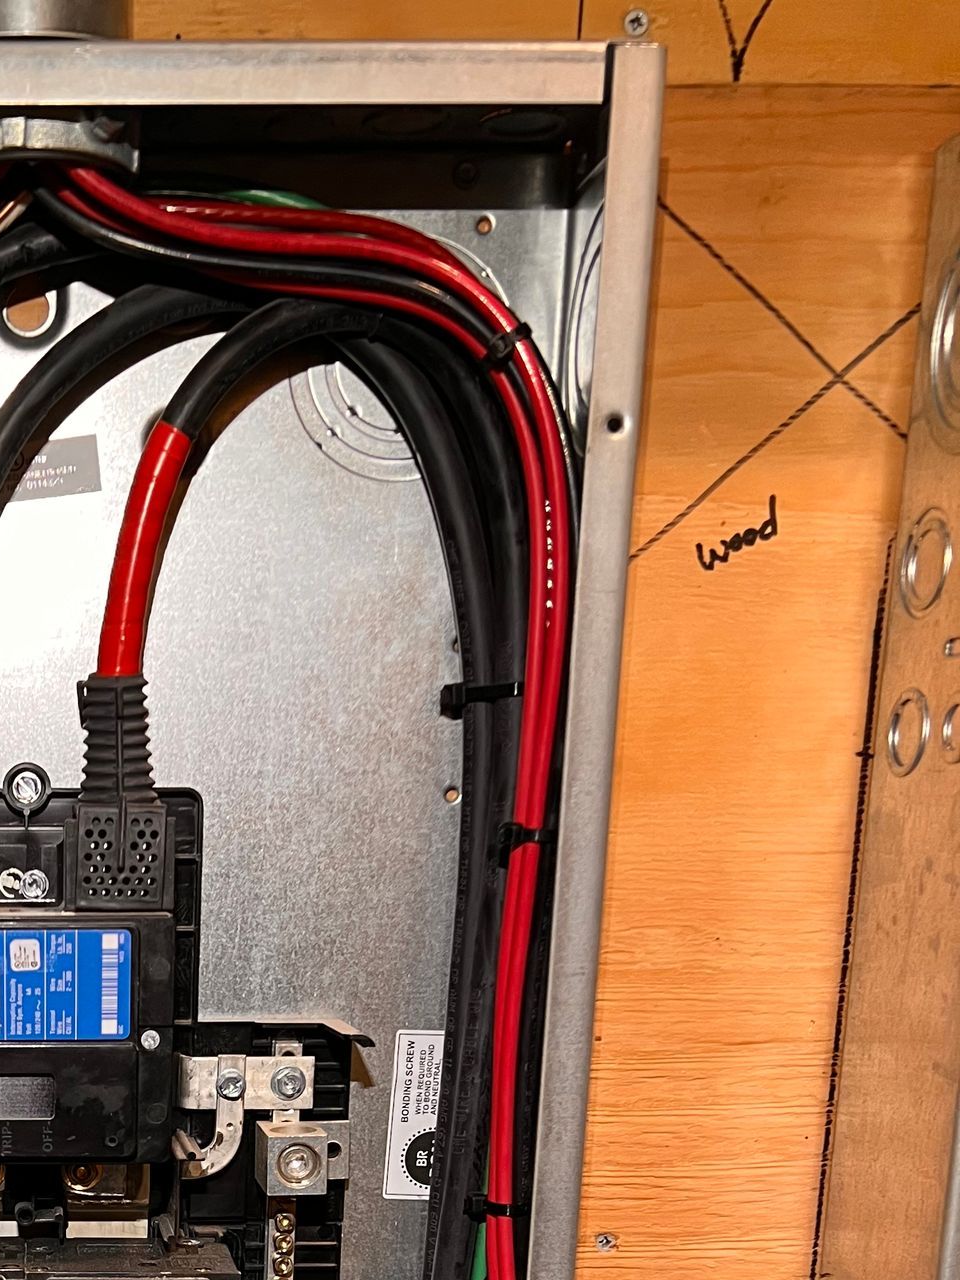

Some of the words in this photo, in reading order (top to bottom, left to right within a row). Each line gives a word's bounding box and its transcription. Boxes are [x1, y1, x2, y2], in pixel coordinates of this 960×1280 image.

[403, 1040, 415, 1076] SCREW
[416, 1049, 427, 1090] REQUIRED
[425, 1044, 435, 1078] GROUND
[400, 1079, 413, 1123] BONDING
[415, 1091, 424, 1116] WHEN
[423, 1080, 432, 1103] BOND
[423, 1104, 430, 1115] TO
[430, 1098, 438, 1116] AND
[416, 1150, 429, 1167] BR
